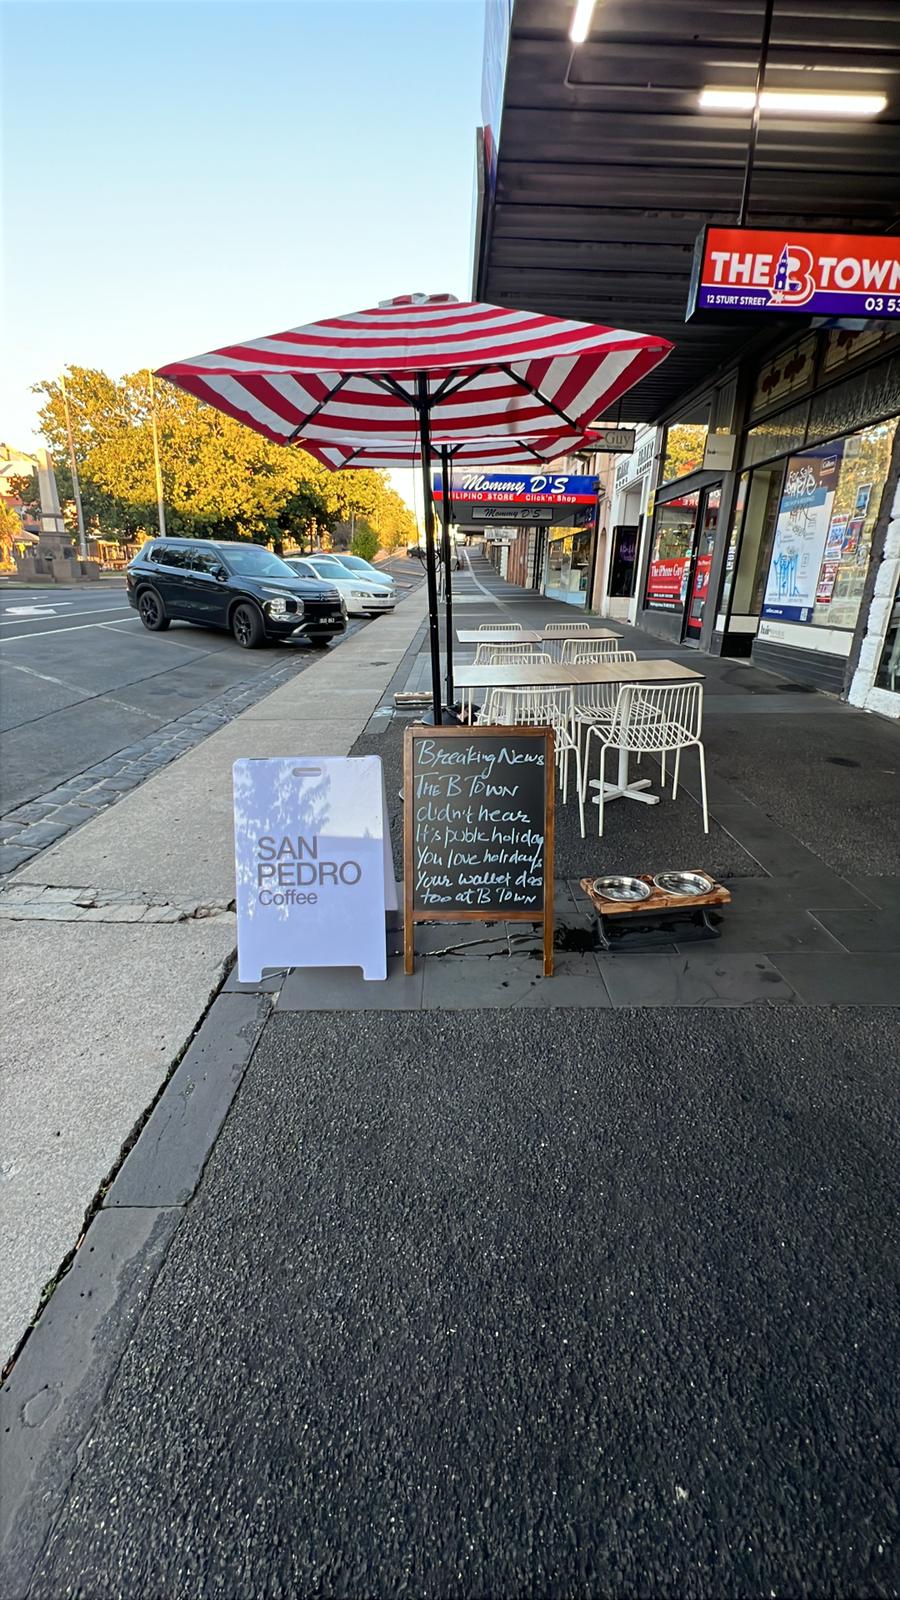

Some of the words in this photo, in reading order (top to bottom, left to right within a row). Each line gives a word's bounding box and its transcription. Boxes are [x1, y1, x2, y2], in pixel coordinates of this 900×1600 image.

[711, 252, 773, 285] THE
[707, 294, 715, 303] 12
[716, 295, 739, 305] STURT
[740, 297, 766, 306] STREET
[865, 298, 884, 311] 03
[605, 431, 631, 449] Guy
[462, 474, 525, 495] Mommy
[530, 476, 569, 494] D'S
[557, 495, 577, 503] Shop
[484, 509, 518, 517] Mommy
[416, 739, 496, 779] Breaking
[498, 747, 545, 766] News
[415, 771, 441, 799] THE
[438, 773, 462, 797] B
[464, 774, 519, 798] TOWN
[416, 802, 473, 824] didn't
[478, 804, 531, 824] hear
[415, 823, 442, 843] It's
[257, 835, 318, 861] SAN
[416, 845, 443, 869] You
[447, 848, 482, 869] love
[257, 860, 362, 887] PEDRO
[415, 870, 453, 891] Your
[457, 871, 512, 888] wallet
[258, 889, 318, 906] Coffee
[420, 887, 453, 905] too
[454, 888, 476, 905] at
[475, 887, 491, 904] B
